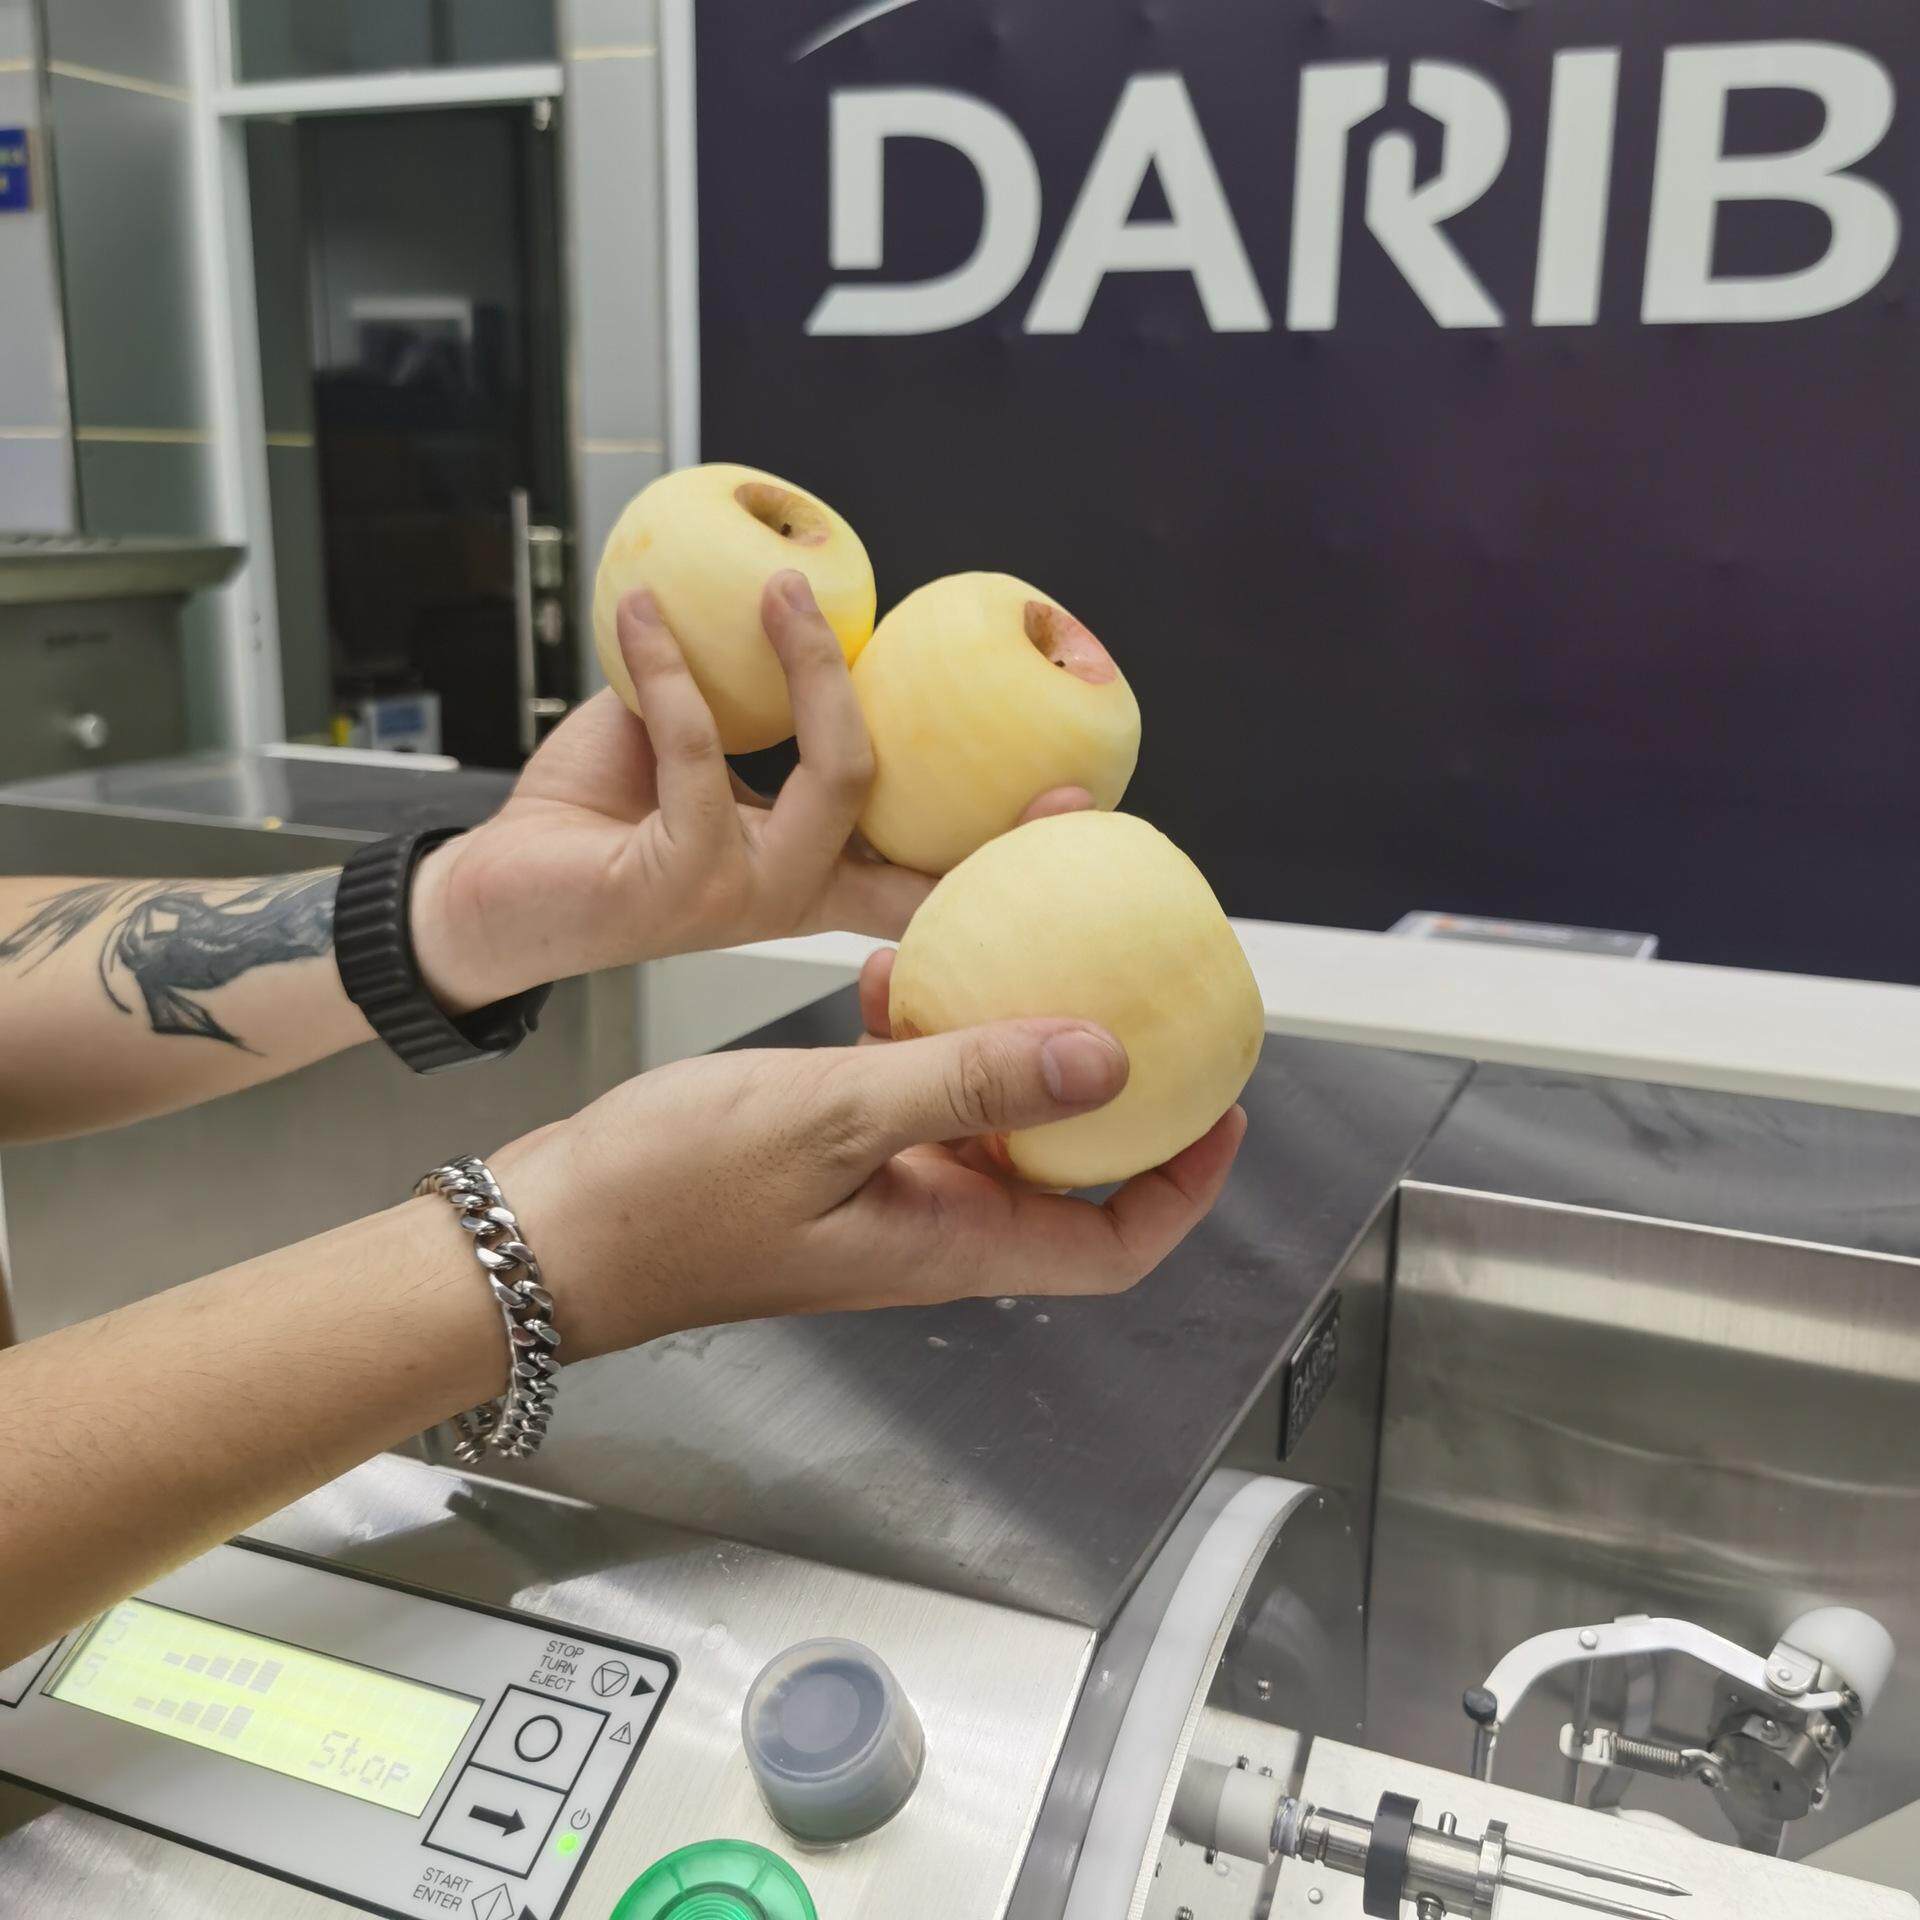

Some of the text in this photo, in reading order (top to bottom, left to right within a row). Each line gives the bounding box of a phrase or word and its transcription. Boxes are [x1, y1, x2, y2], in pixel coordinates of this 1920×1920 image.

[804, 39, 1900, 336] DARIB
[546, 1640, 584, 1659] STOP
[539, 1654, 578, 1675] TURN
[529, 1670, 575, 1692] EJECT
[422, 1867, 472, 1893] START
[412, 1884, 462, 1911] ENTER
